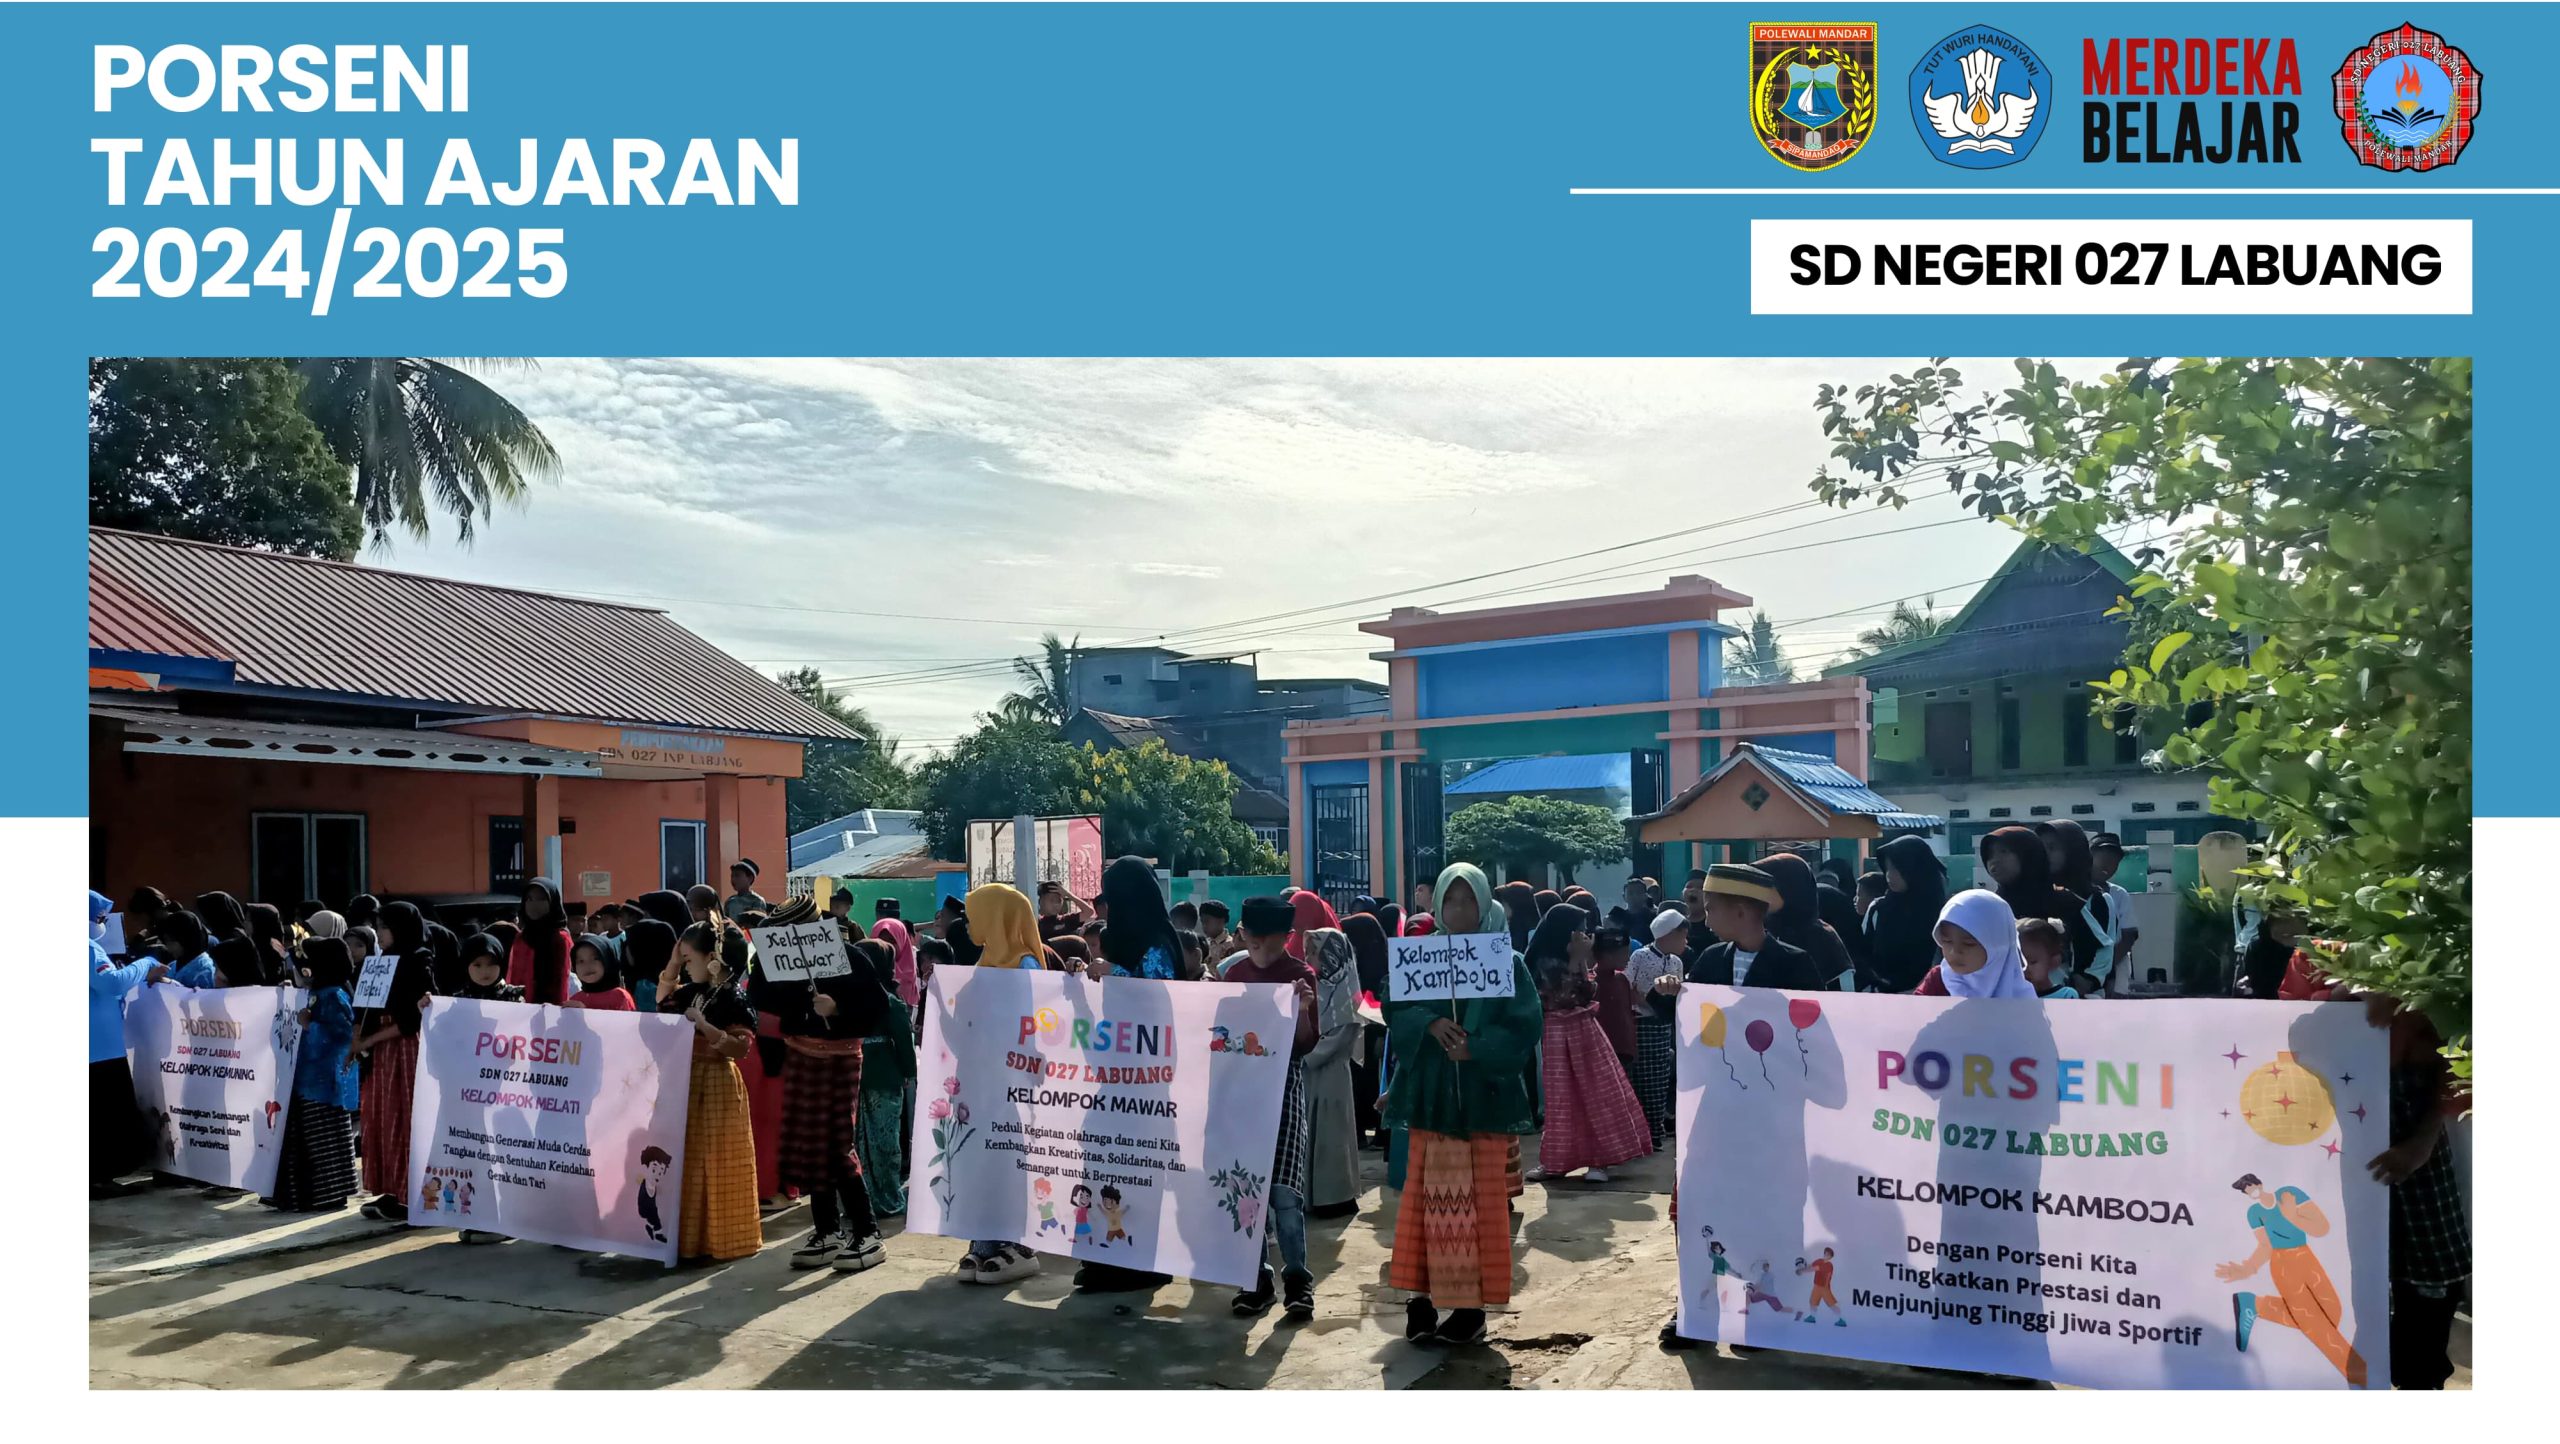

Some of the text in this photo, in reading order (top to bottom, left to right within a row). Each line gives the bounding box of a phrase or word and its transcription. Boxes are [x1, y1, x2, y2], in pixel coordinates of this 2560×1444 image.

[631, 750, 657, 762] 027
[663, 752, 684, 764] INP
[766, 926, 834, 948] Kelompok
[774, 953, 834, 971] Mawar
[1395, 938, 1478, 968] Kelompok
[1404, 963, 1501, 995] Kamboja
[180, 1018, 242, 1040] PORSENI
[1017, 1014, 1173, 1057] PORSENI
[177, 1045, 241, 1059] SDN 027 LABUANG
[475, 1032, 582, 1066] PORSENI
[160, 1061, 255, 1081] KELOMPOK KEMUNING
[479, 1067, 569, 1087] SDN 027 LABUANG
[1006, 1050, 1173, 1084] SDN 027 LABUANG
[1877, 1050, 2174, 1109] PORSENI
[212, 1110, 251, 1123] Semangat
[461, 1088, 580, 1115] KELOMPOK MELATI
[1007, 1086, 1178, 1118] KELOMPOK MAWAR
[226, 1126, 241, 1137] dan
[448, 1126, 591, 1157] Membangun Generasi Muda Cerdas
[991, 1121, 1181, 1152] Peduli Kegiatan olahraga dan seni Kita
[1872, 1108, 2168, 1157] SDN 027 LABUANG
[442, 1144, 595, 1177] Tangkas dengan Sentuhan Keindahan
[984, 1139, 1186, 1172] Kembangkan Kreativitas, Solidaritas, dan
[487, 1169, 547, 1190] Gerak dan Tari
[1016, 1159, 1153, 1188] Semangat untuk Berprestasi
[1857, 1175, 2194, 1226] KELOMPOK KAMBOJA
[1907, 1235, 2137, 1275] Dengan Porseni Kita
[1885, 1262, 2162, 1310] Tingkatkan Prestasi dan
[1852, 1289, 2203, 1347] Menjunjung Tinggi Jiwa Sportif
